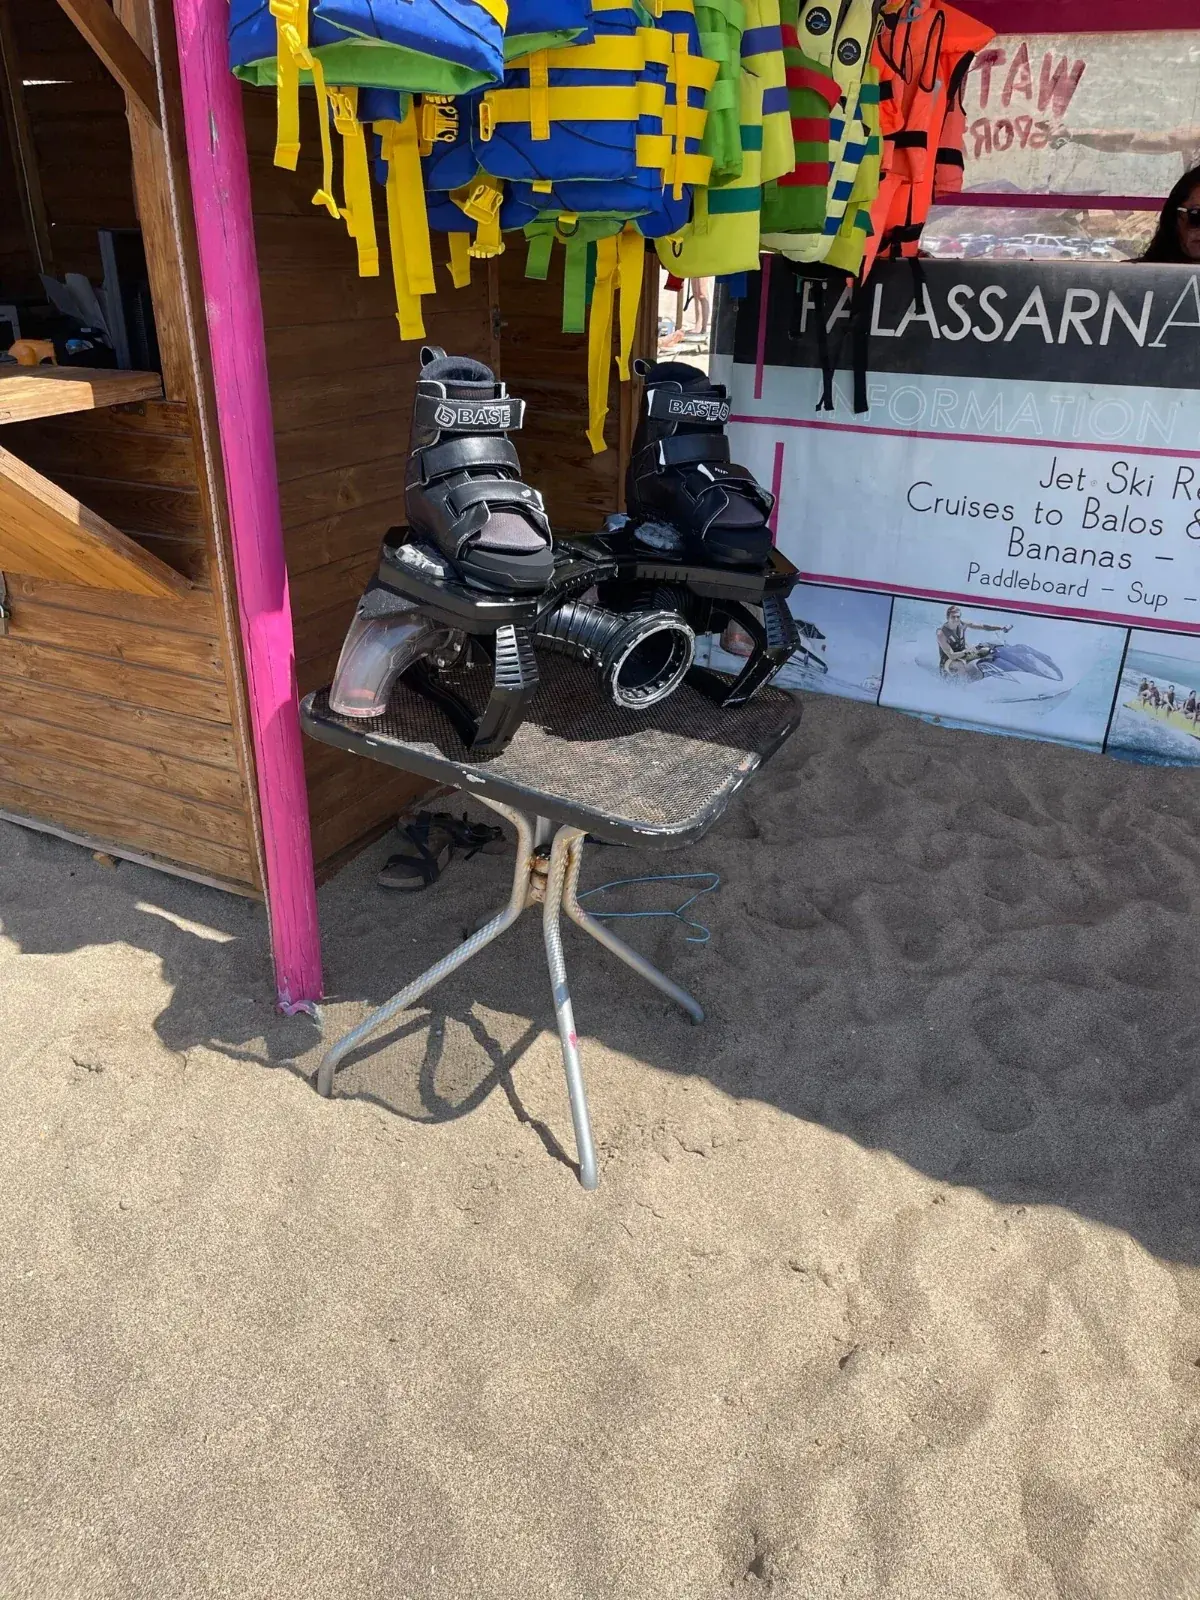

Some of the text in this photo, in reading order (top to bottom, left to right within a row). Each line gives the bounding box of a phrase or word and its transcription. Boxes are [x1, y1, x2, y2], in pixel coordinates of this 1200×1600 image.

[457, 408, 511, 425] BASE
[669, 399, 720, 418] BASE
[1040, 456, 1200, 501] Jet Ski R
[907, 481, 1015, 521] Cruises
[1034, 501, 1063, 526] to
[1082, 496, 1164, 536] Balos
[1008, 526, 1132, 570] Bananas
[967, 561, 1089, 598] Paddleboard
[1127, 581, 1168, 613] Sup
